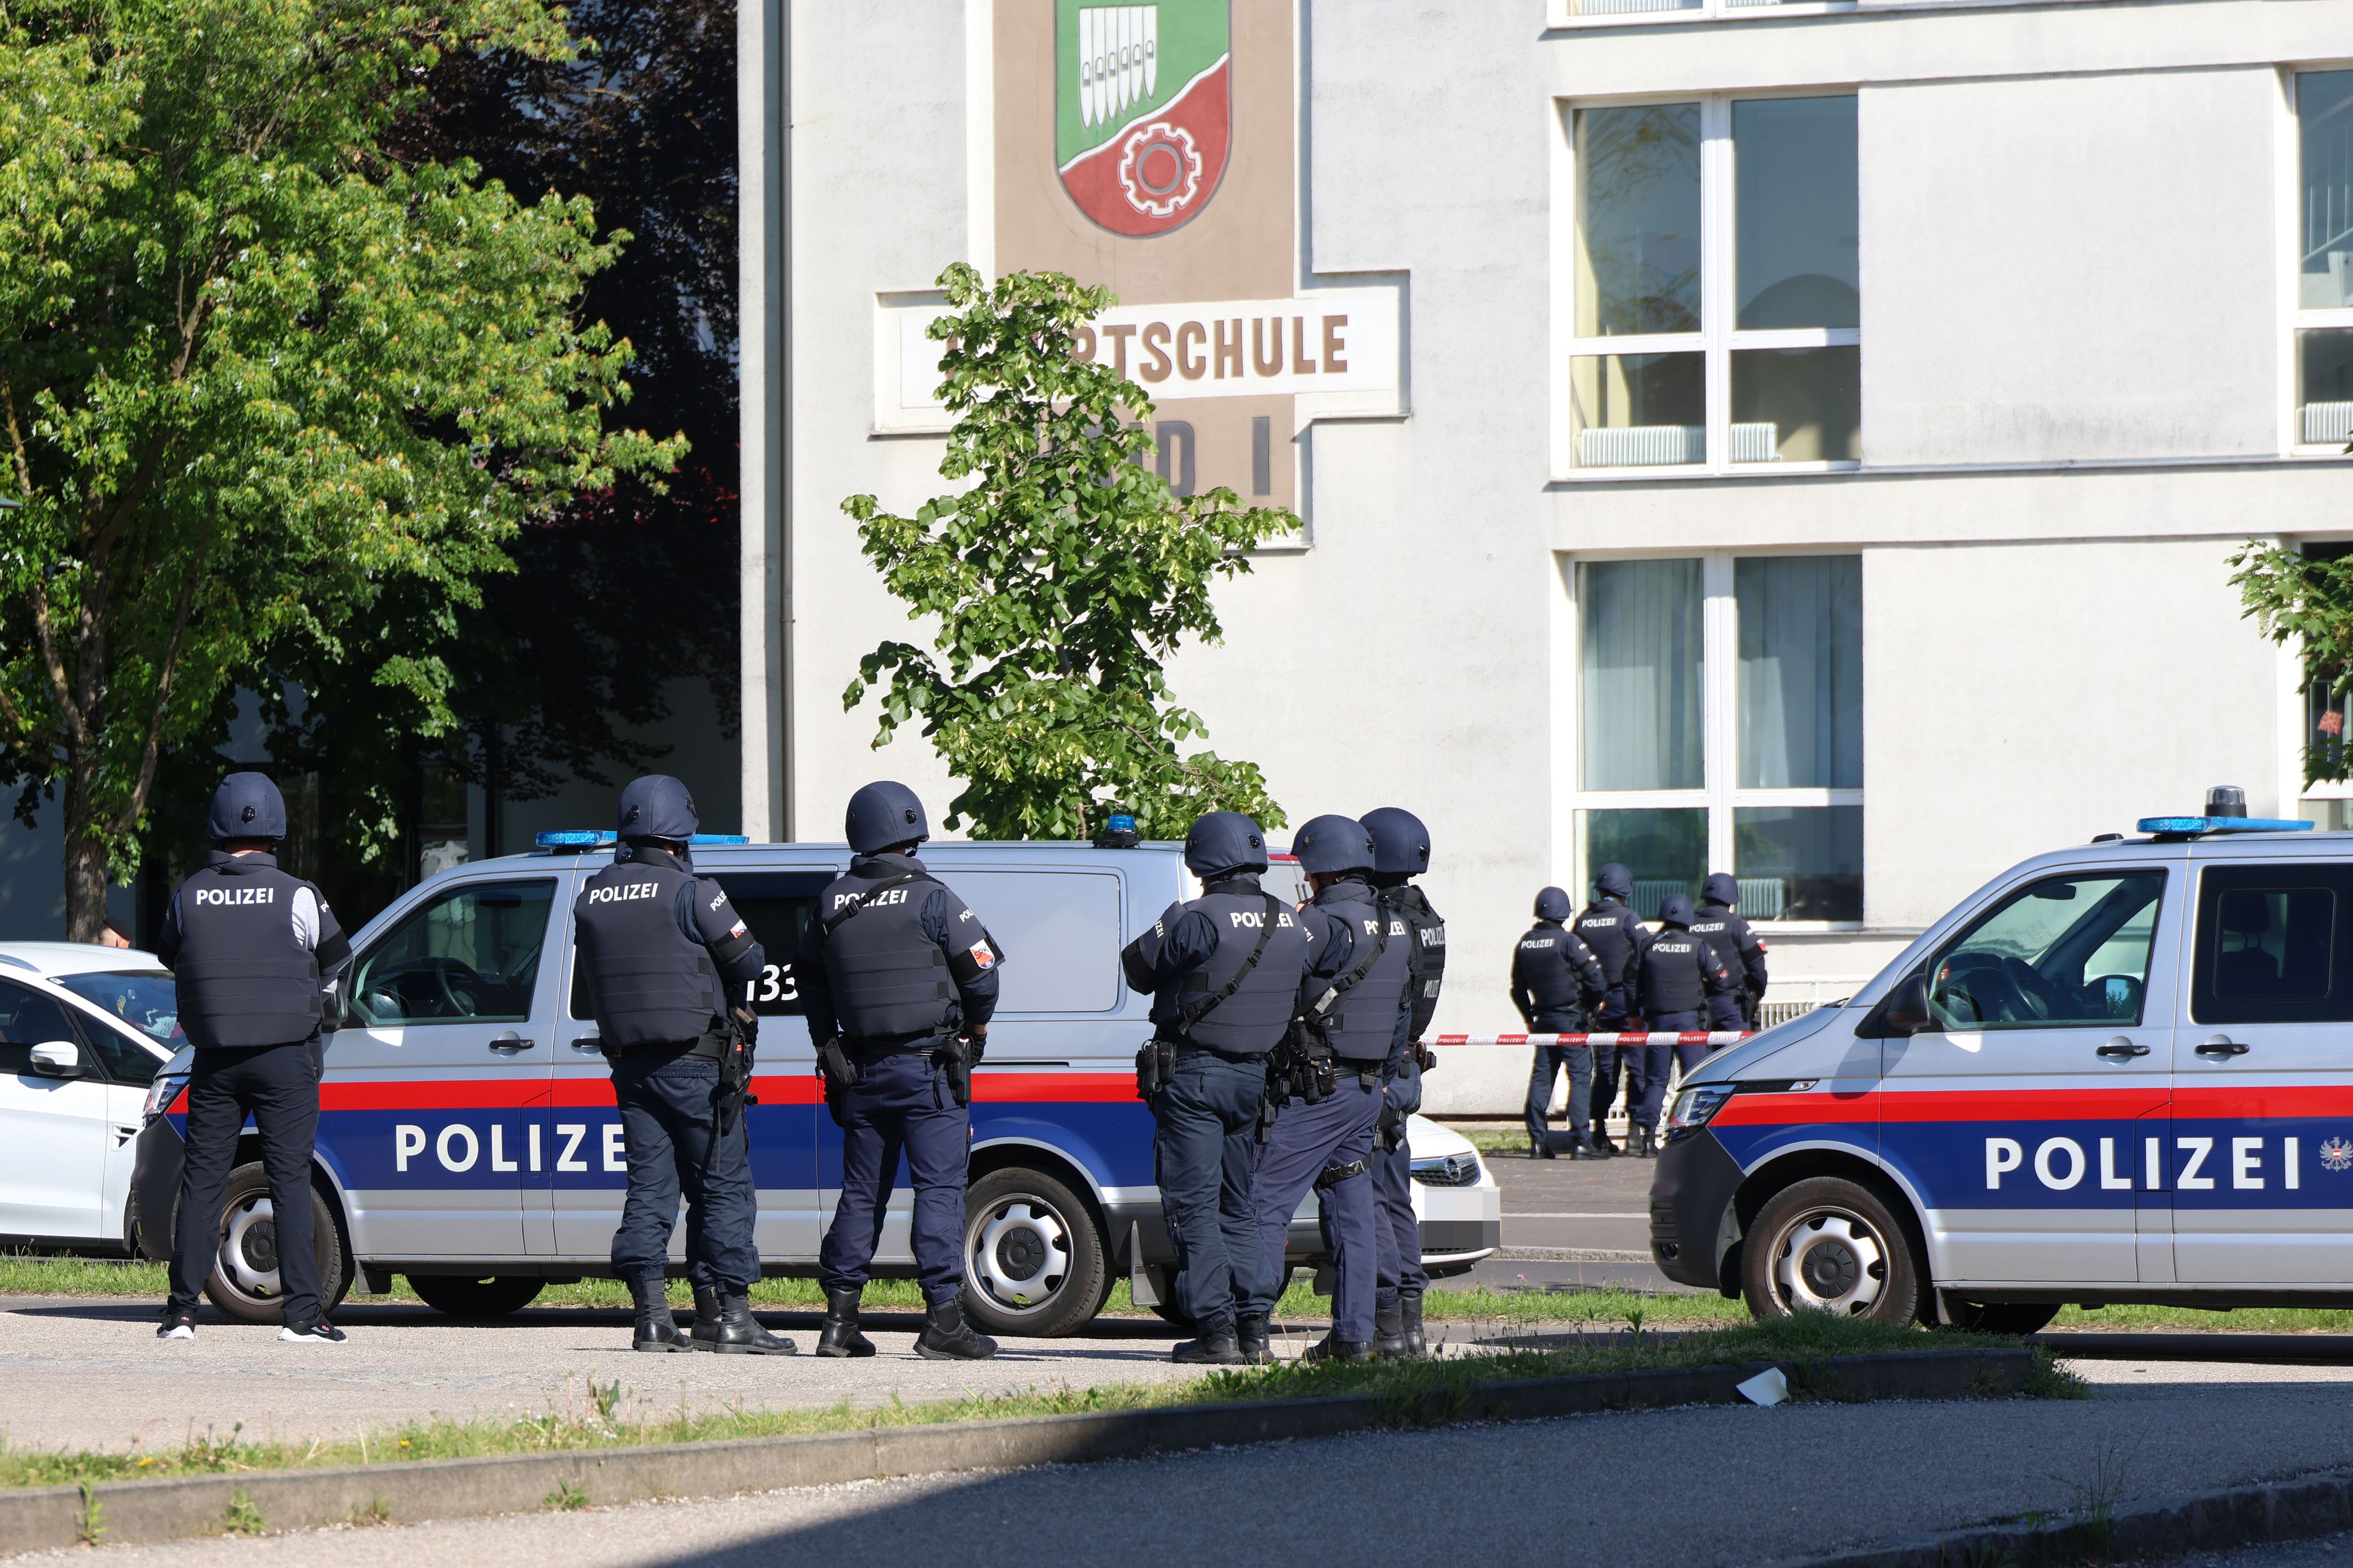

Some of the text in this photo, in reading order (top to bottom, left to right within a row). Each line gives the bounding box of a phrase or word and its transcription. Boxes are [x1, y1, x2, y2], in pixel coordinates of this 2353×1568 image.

[196, 888, 274, 905] POLIZEI
[589, 883, 659, 905] POLIZEI
[1581, 918, 1615, 928] POLIZEI
[1689, 922, 1724, 933] POLIZEI
[1521, 939, 1554, 949] POLIZEI
[1652, 943, 1689, 953] POLIZEI
[1986, 1137, 2299, 1190] POLIZEI
